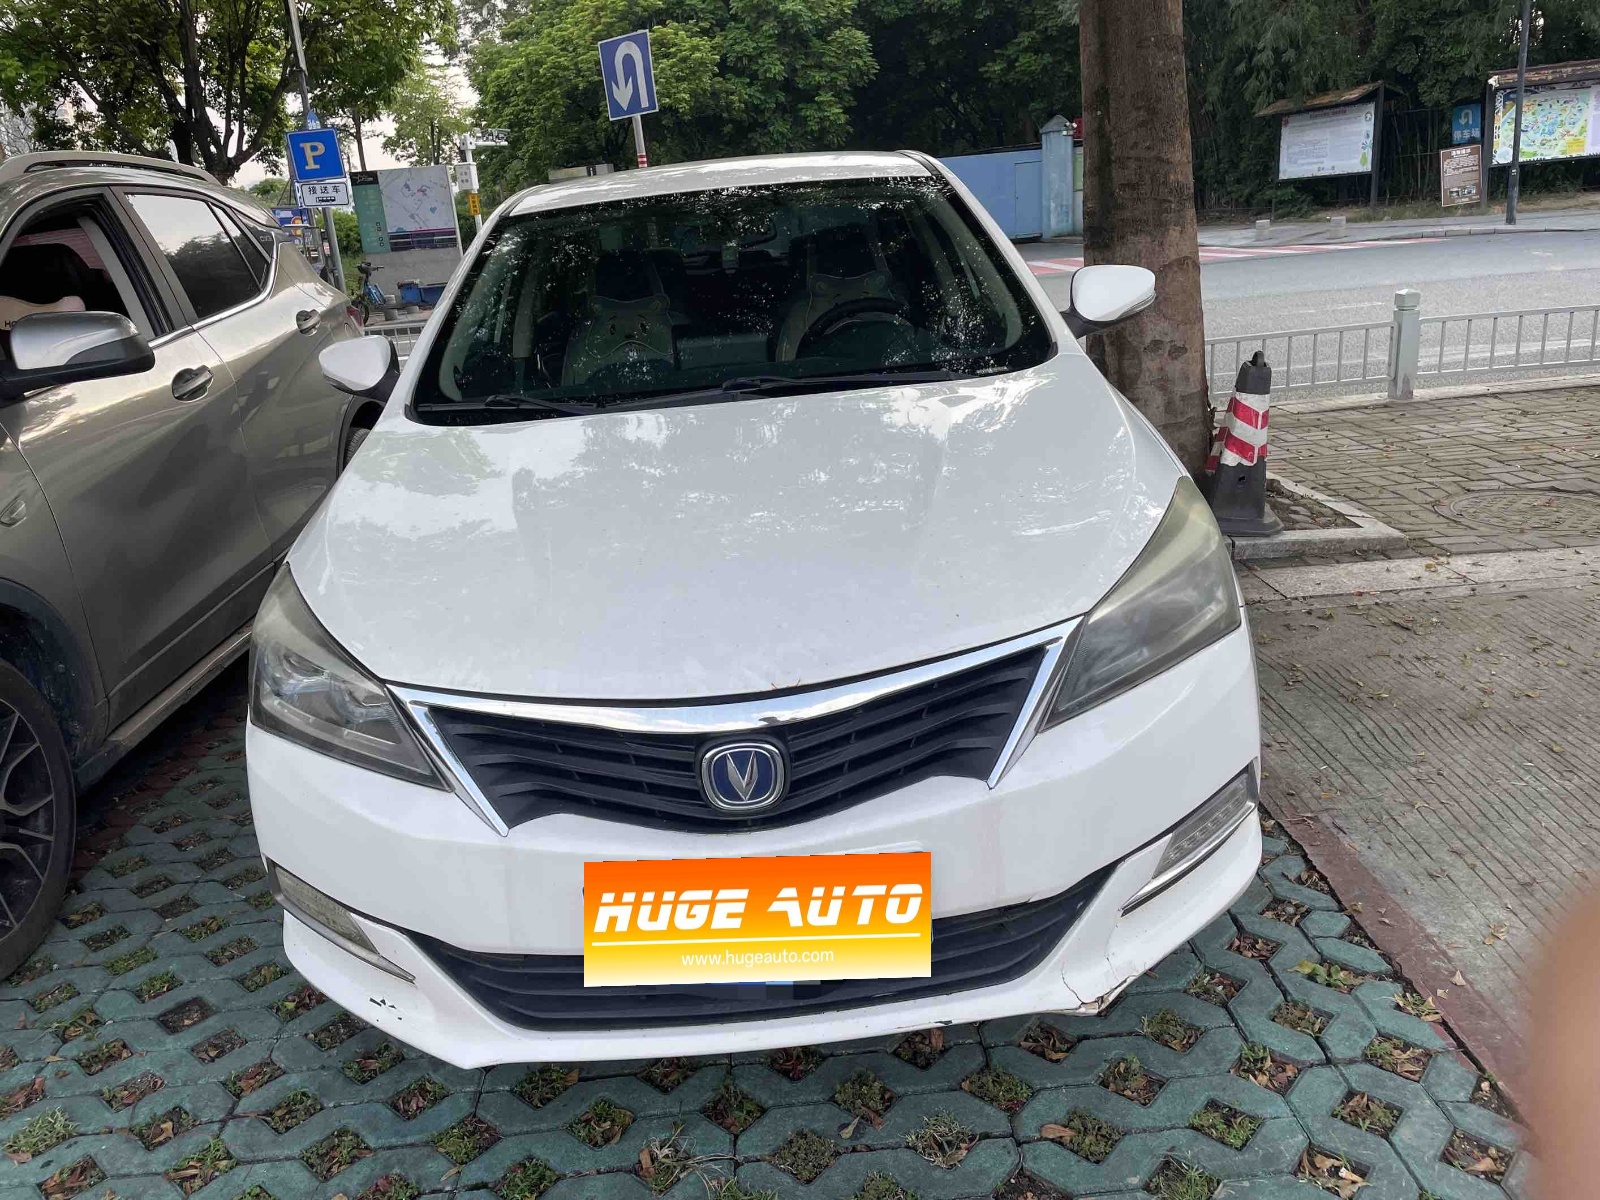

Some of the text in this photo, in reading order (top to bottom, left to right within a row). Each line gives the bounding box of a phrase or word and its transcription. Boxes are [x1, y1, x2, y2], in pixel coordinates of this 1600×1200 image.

[300, 142, 326, 170] P
[308, 185, 341, 195] 接送车
